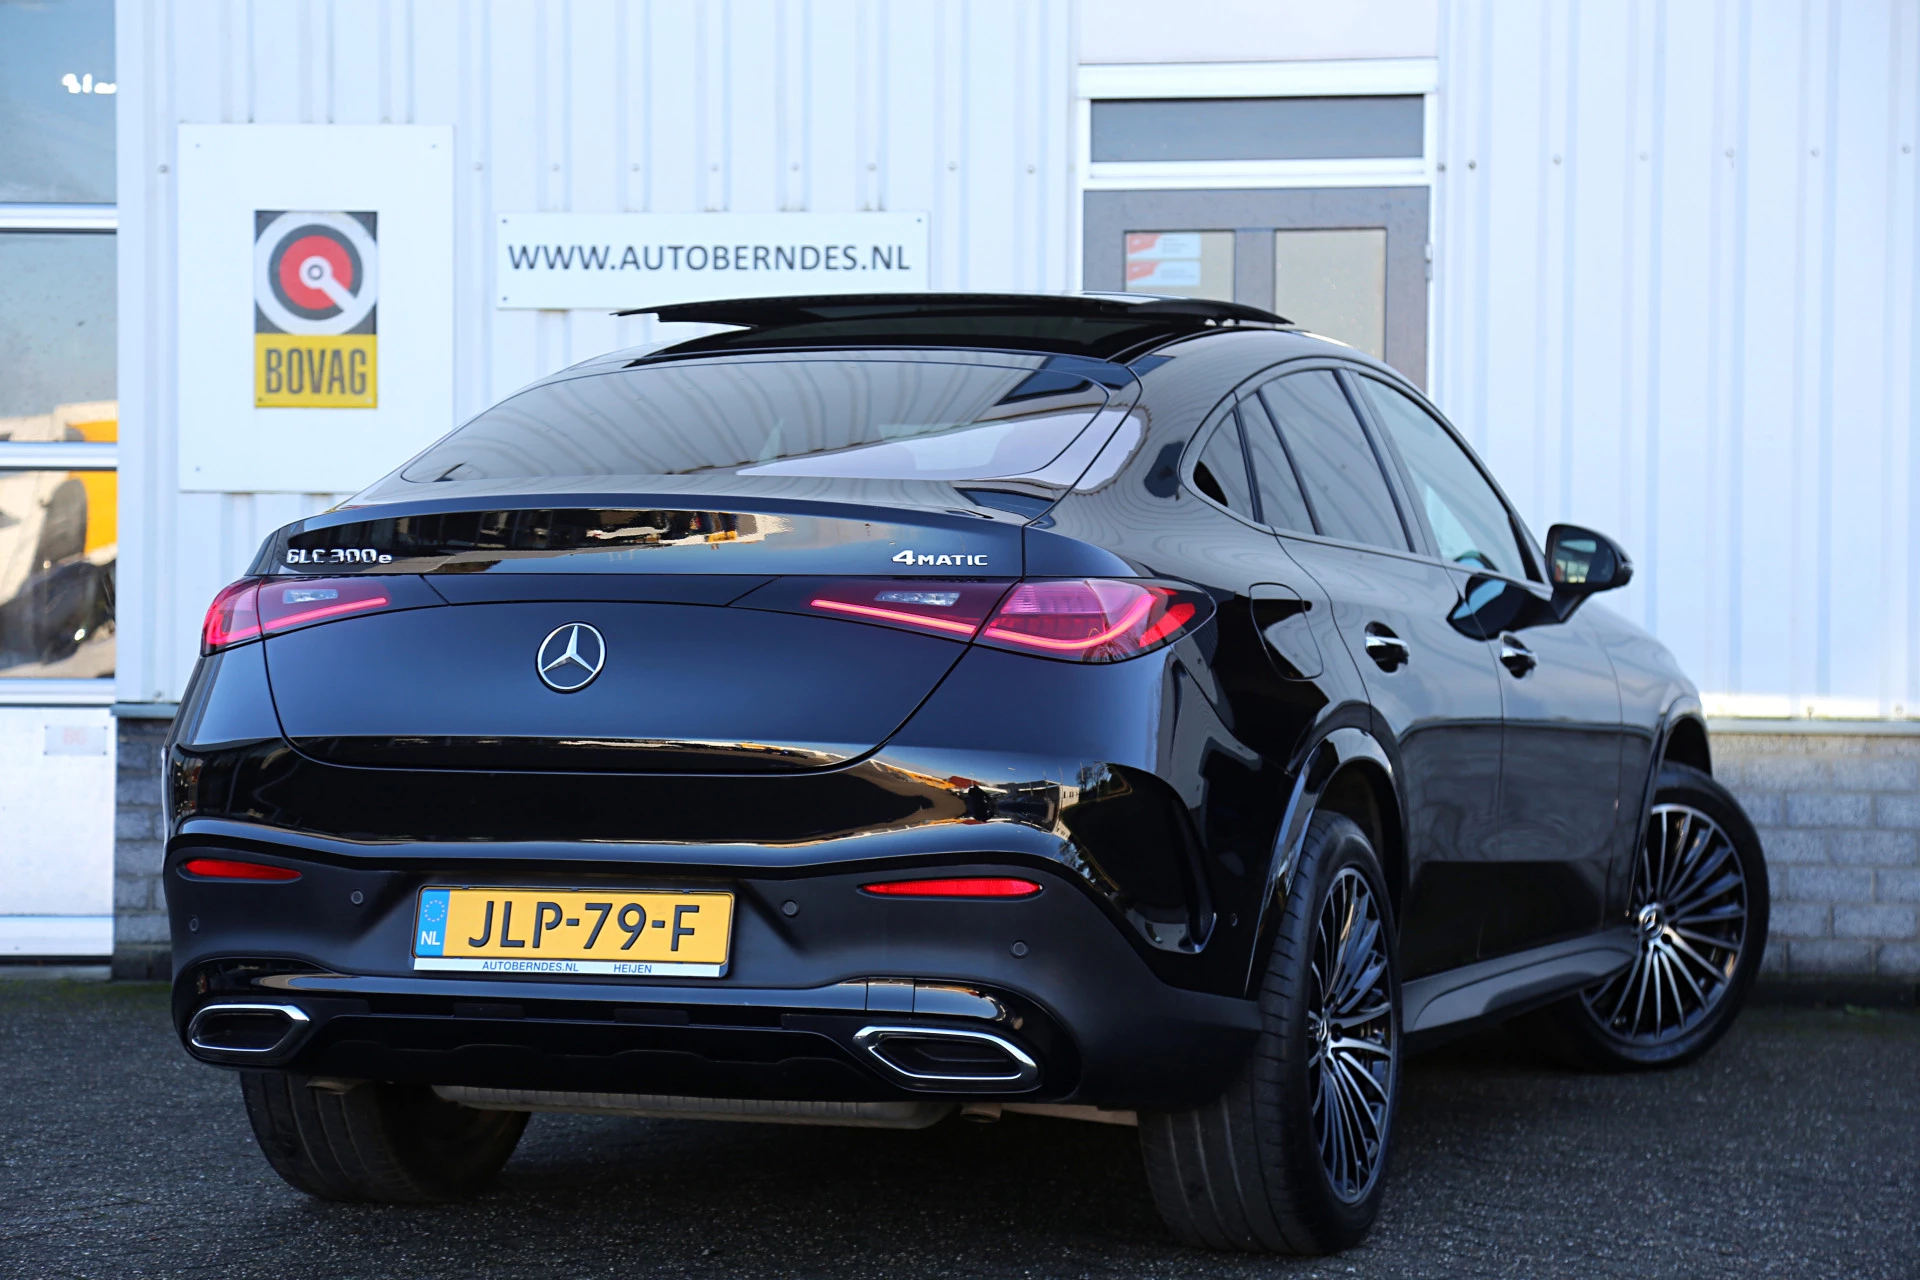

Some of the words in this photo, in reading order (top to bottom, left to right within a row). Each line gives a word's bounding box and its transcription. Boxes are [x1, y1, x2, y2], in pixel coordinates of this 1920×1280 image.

[508, 244, 911, 270] WWW.AUTOBERNDES.NL
[265, 348, 367, 395] BOVAG
[286, 548, 326, 564] GLC
[329, 548, 393, 564] 300e
[892, 549, 988, 566] 4MATIC
[468, 900, 700, 952] JLP-79-F
[421, 931, 441, 946] NL
[482, 961, 579, 972] AUTOBERNDES.NL
[613, 964, 652, 974] HEIJEN
